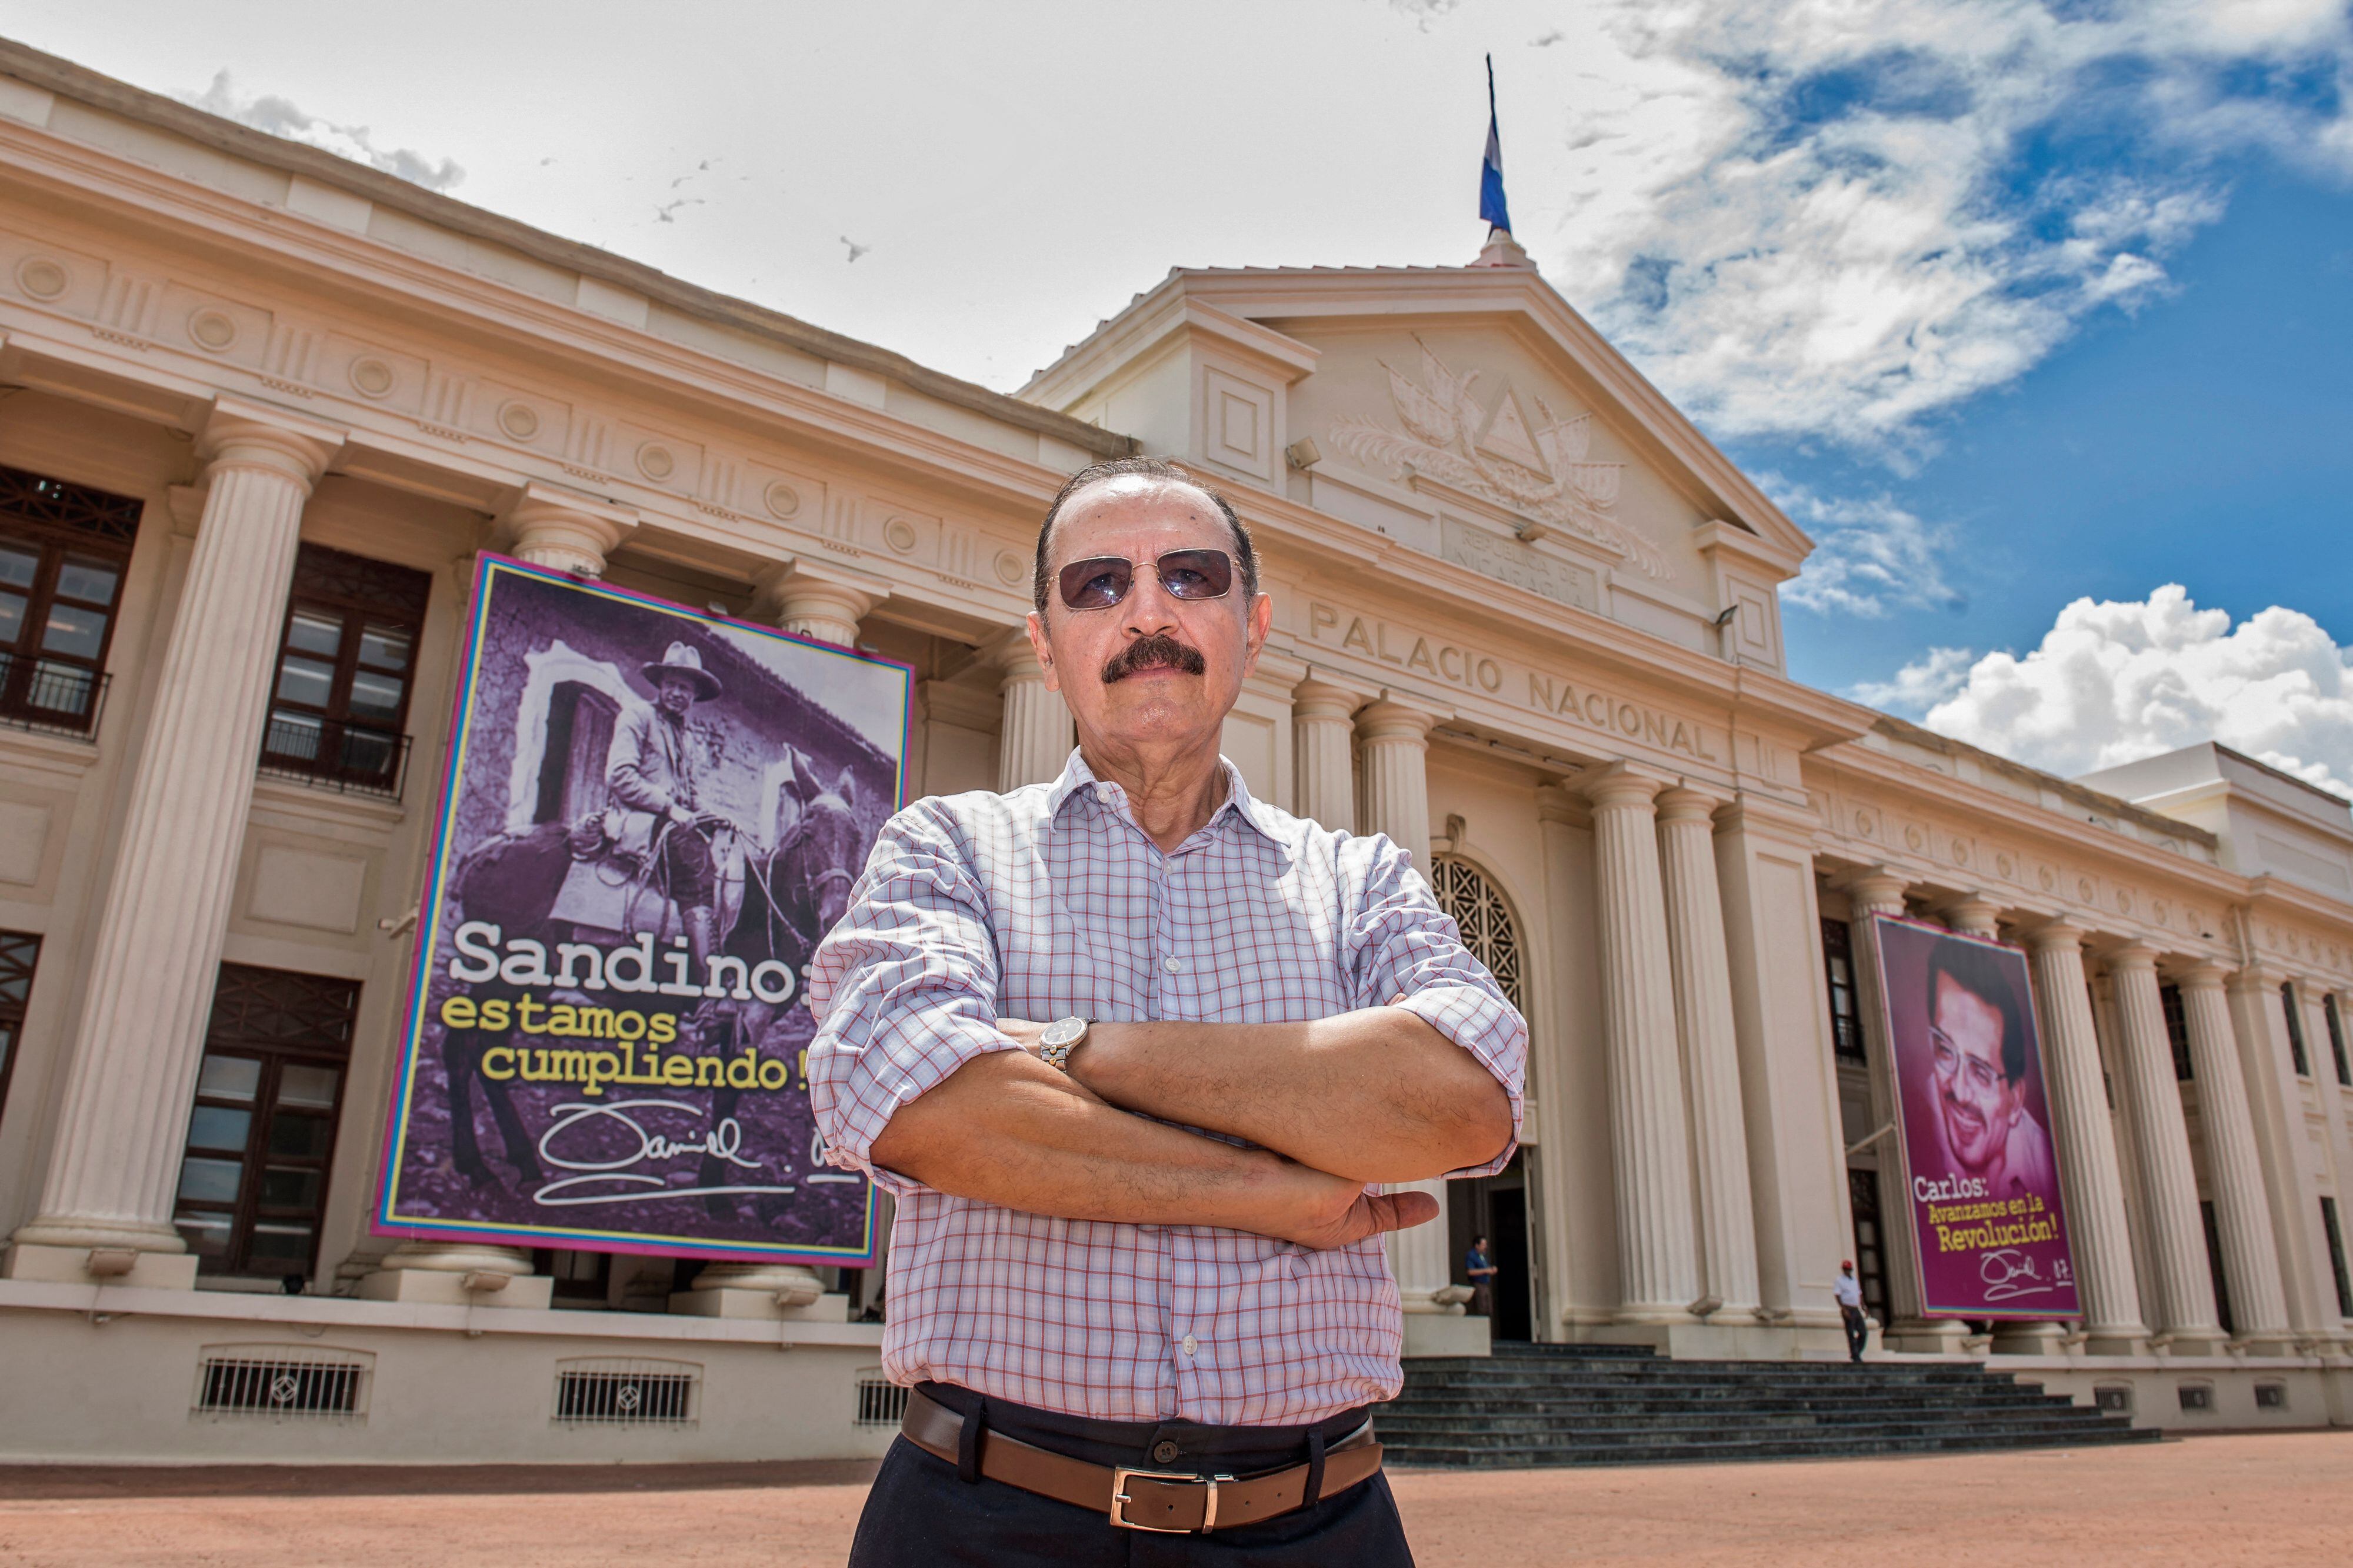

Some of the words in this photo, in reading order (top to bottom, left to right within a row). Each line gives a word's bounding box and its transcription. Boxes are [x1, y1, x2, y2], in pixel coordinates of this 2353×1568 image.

[1559, 565, 1578, 586] DE
[1310, 602, 1501, 693] PALACIO
[1529, 673, 1716, 762] NACIONAL
[449, 920, 811, 1005] Sandino:
[441, 993, 677, 1043] estamos
[481, 1042, 806, 1096] cumpliendo!
[1914, 1172, 1989, 1202] Carlos:
[1928, 1203, 2008, 1225] Avanzamos
[2008, 1197, 2028, 1215] en
[2025, 1192, 2045, 1213] la
[1935, 1212, 2059, 1253] Revolución!
